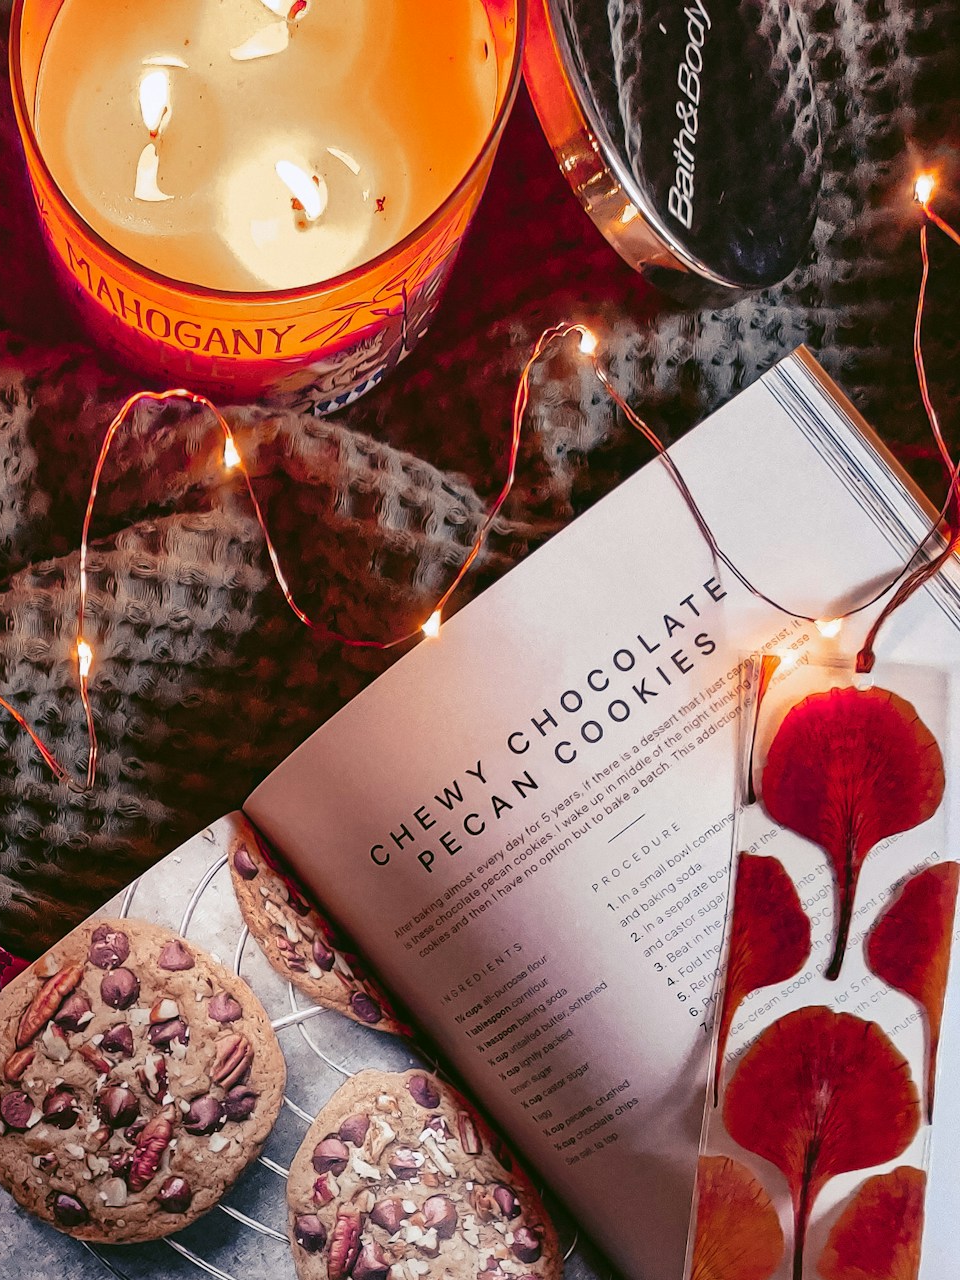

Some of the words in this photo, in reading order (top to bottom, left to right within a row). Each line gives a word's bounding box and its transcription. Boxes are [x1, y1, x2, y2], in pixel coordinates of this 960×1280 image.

[65, 237, 295, 355] MAHOGANY
[369, 761, 487, 867] CHEWY
[507, 577, 727, 756] CHOCOLATE
[418, 770, 539, 873] PECAN
[554, 631, 717, 764] COOKIES
[411, 895, 445, 925] baking
[441, 869, 477, 900] almost
[474, 848, 507, 877] every
[502, 830, 528, 854] day
[523, 818, 543, 837] for
[539, 811, 552, 824] 5
[550, 787, 586, 819] years,
[590, 757, 621, 784] there
[638, 712, 679, 748] dessert
[677, 696, 701, 717] that
[703, 676, 727, 698] just
[417, 929, 451, 958] cookies
[448, 915, 470, 934] and
[467, 897, 493, 920] then
[496, 873, 524, 897] have
[536, 834, 575, 868] option
[570, 820, 592, 840] but
[602, 789, 631, 815] bake
[637, 757, 673, 787] batch.
[671, 739, 696, 761] This
[693, 702, 743, 744] addiction
[432, 886, 481, 927] chocolate
[479, 862, 514, 893] pecan
[510, 827, 557, 866] cookies.
[559, 802, 590, 828] wake
[588, 791, 607, 808] up
[614, 753, 652, 785] middle
[663, 729, 683, 748] the
[681, 708, 711, 735] night
[708, 677, 752, 714] thinking
[590, 821, 682, 893] PROCEDURE
[636, 863, 668, 889] small
[665, 844, 693, 868] bowl
[690, 811, 737, 849] combine
[638, 880, 677, 913] baking
[673, 860, 703, 885] soda
[661, 879, 711, 920] separate
[662, 913, 697, 942] castor
[695, 891, 730, 920] sugar
[438, 941, 523, 1006] INGREDIENTS
[544, 986, 567, 1006] soda
